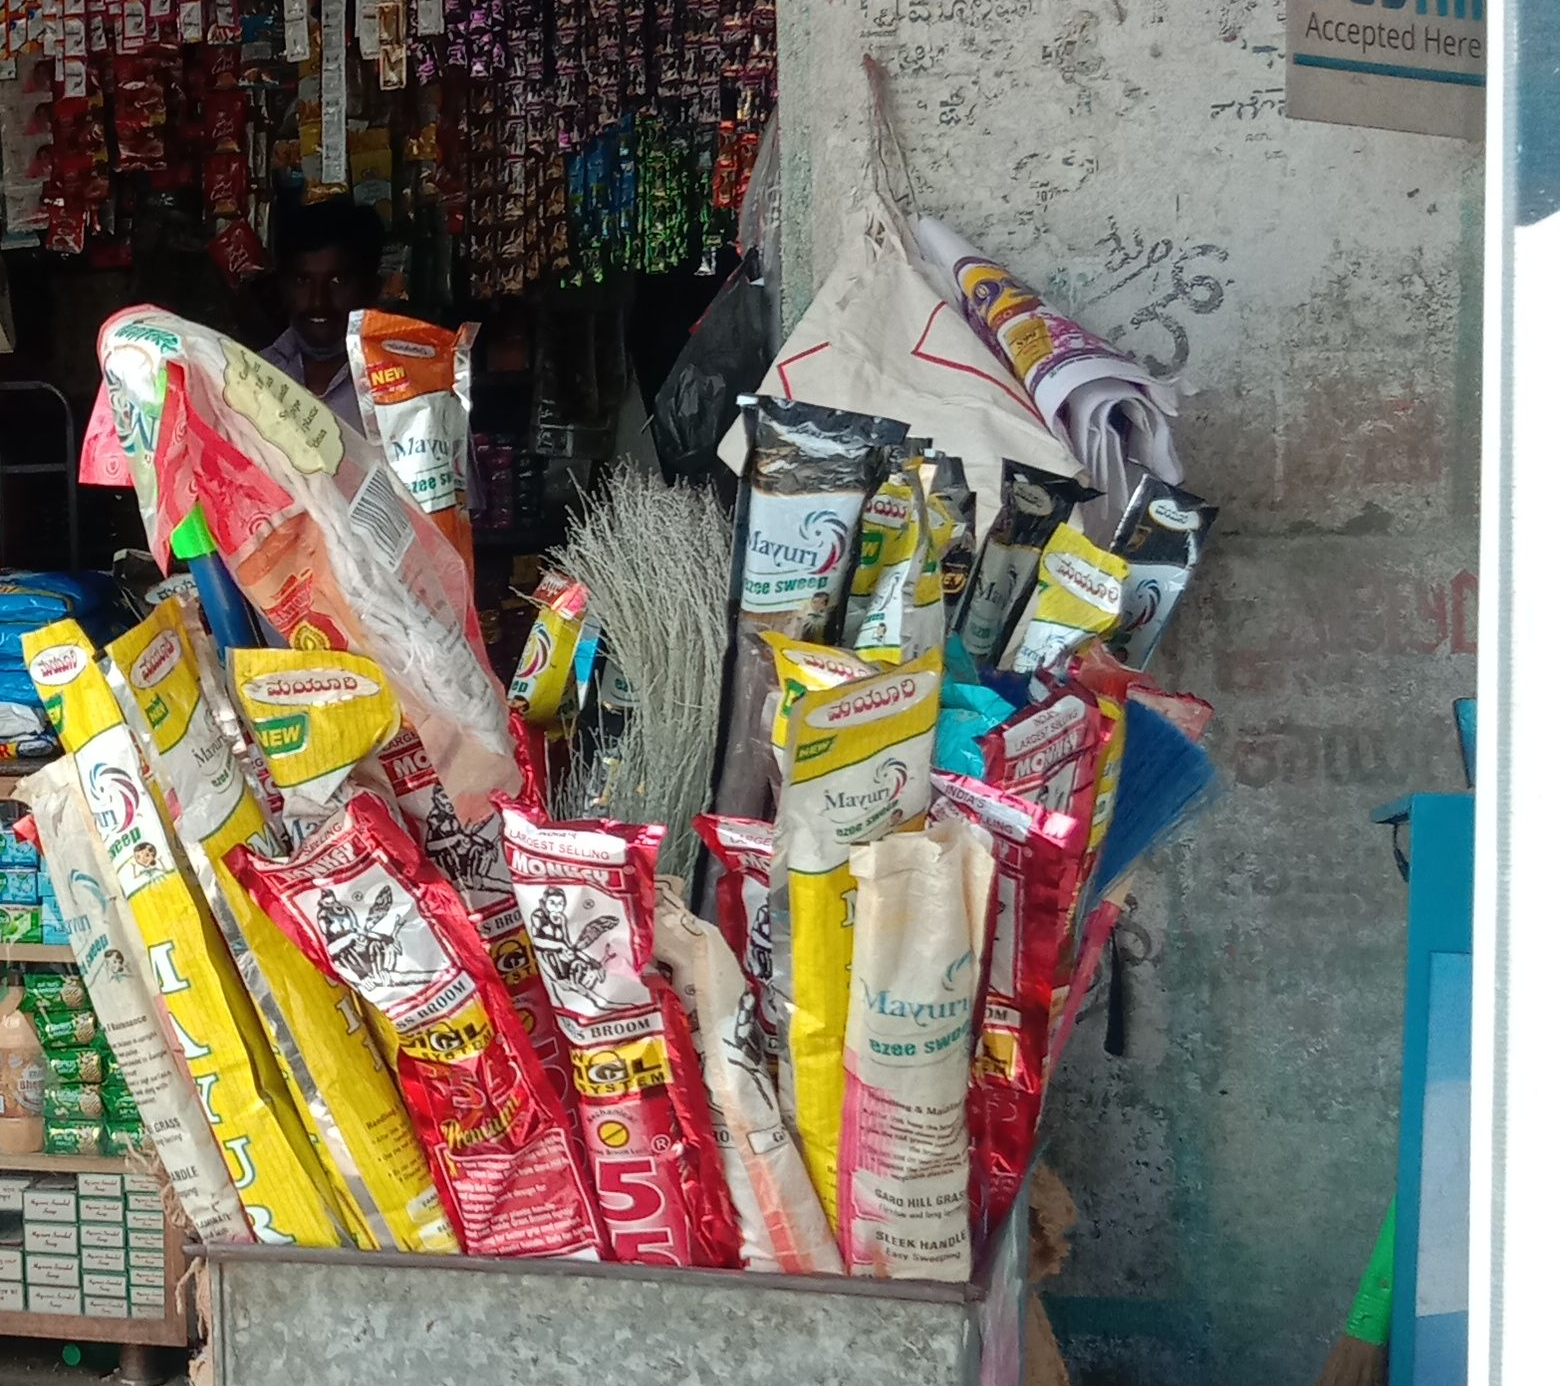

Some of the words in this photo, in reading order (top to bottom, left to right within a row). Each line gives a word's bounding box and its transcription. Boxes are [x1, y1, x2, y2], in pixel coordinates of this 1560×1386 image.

[1305, 12, 1416, 54] Accepted
[1424, 28, 1482, 59] Here
[371, 369, 406, 387] NEW
[775, 574, 829, 593] sweep
[267, 676, 358, 697] ಮಯೂರಿ
[827, 677, 917, 723] ಮಯೂರಿ
[258, 723, 301, 749] NEW
[797, 736, 835, 759] NEW
[823, 787, 892, 813] Mayuri
[945, 783, 987, 810] INDIA'S
[508, 828, 555, 852] LARGEST
[416, 979, 468, 1020] BROOM
[864, 978, 970, 1028] Mayuri
[590, 1018, 652, 1040] BROOM
[595, 1156, 666, 1225] 5
[907, 1194, 932, 1209] HILL
[875, 1229, 917, 1250] SLEEK
[919, 1229, 967, 1251] HANDLE
